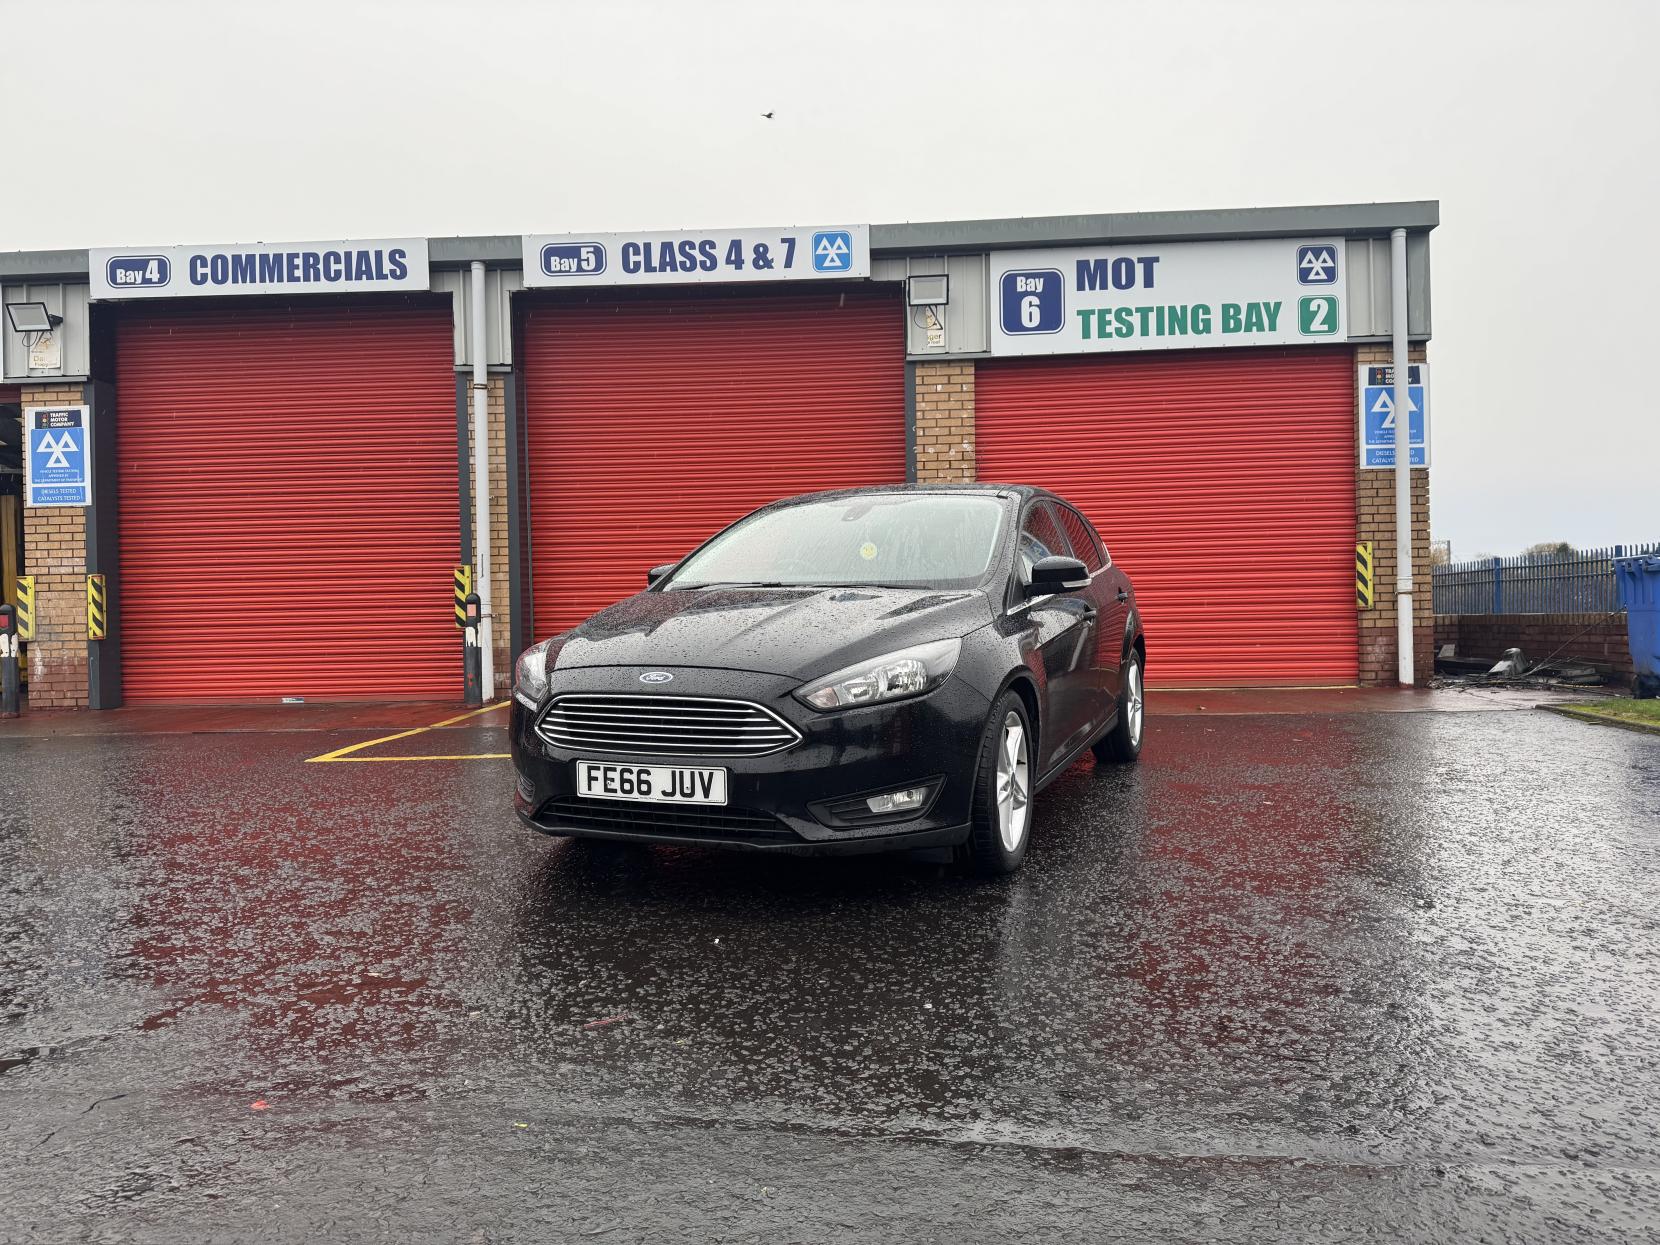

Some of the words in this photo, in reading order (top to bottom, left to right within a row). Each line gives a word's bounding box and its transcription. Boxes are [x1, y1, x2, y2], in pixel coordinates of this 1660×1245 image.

[189, 248, 408, 286] COMMERCIALS
[550, 256, 578, 273] Bay
[581, 247, 596, 270] 5
[621, 240, 718, 274] CLASS
[725, 239, 744, 271] 4
[752, 243, 775, 269] &
[780, 237, 797, 268] 7
[116, 268, 143, 286] Bay
[145, 260, 160, 283] 4
[1016, 276, 1045, 293] Bay
[1075, 256, 1160, 292] MOT
[1020, 295, 1041, 328] 6
[1076, 304, 1212, 340] TESTING
[1216, 302, 1282, 333] BAY
[1310, 299, 1329, 331] 2
[586, 765, 652, 796] FE66
[660, 770, 714, 799] JUV
